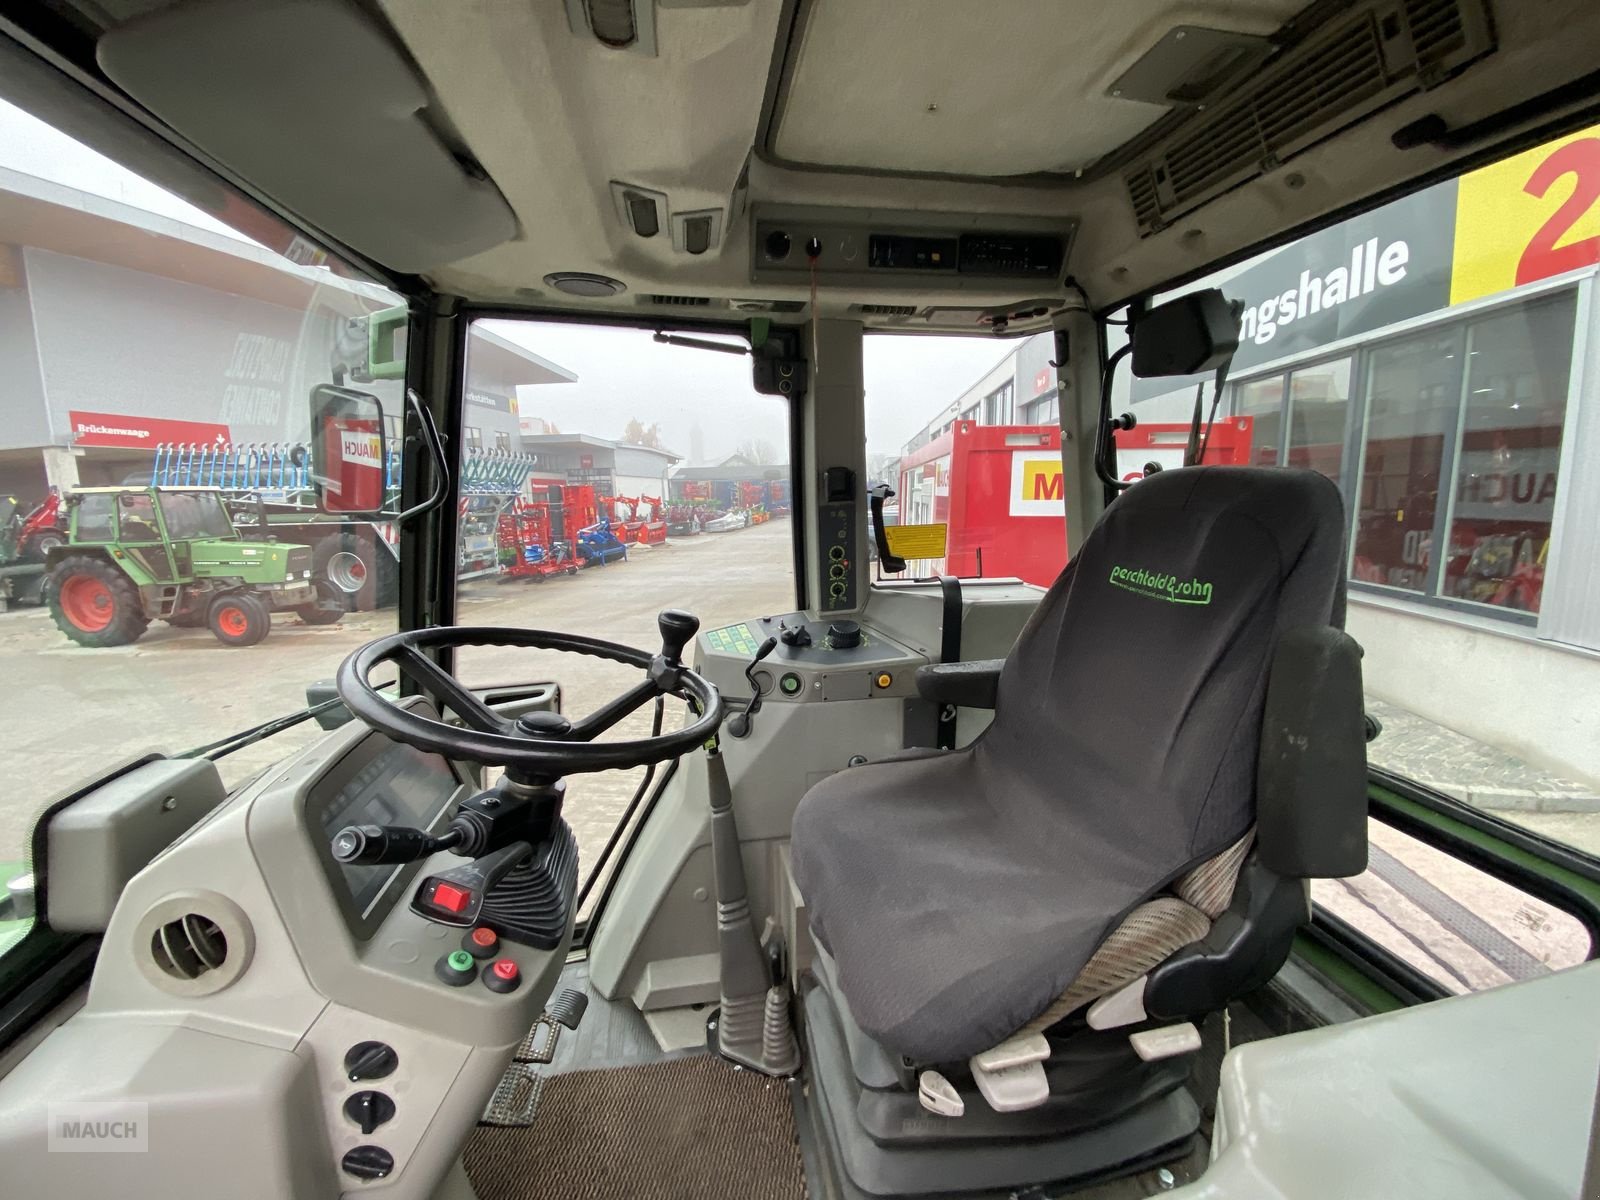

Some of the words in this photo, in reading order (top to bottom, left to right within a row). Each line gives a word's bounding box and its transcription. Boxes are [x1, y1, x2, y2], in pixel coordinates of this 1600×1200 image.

[1238, 236, 1410, 345] ngshalle
[1515, 137, 1600, 287] 2
[77, 423, 150, 438] Brückenwaage
